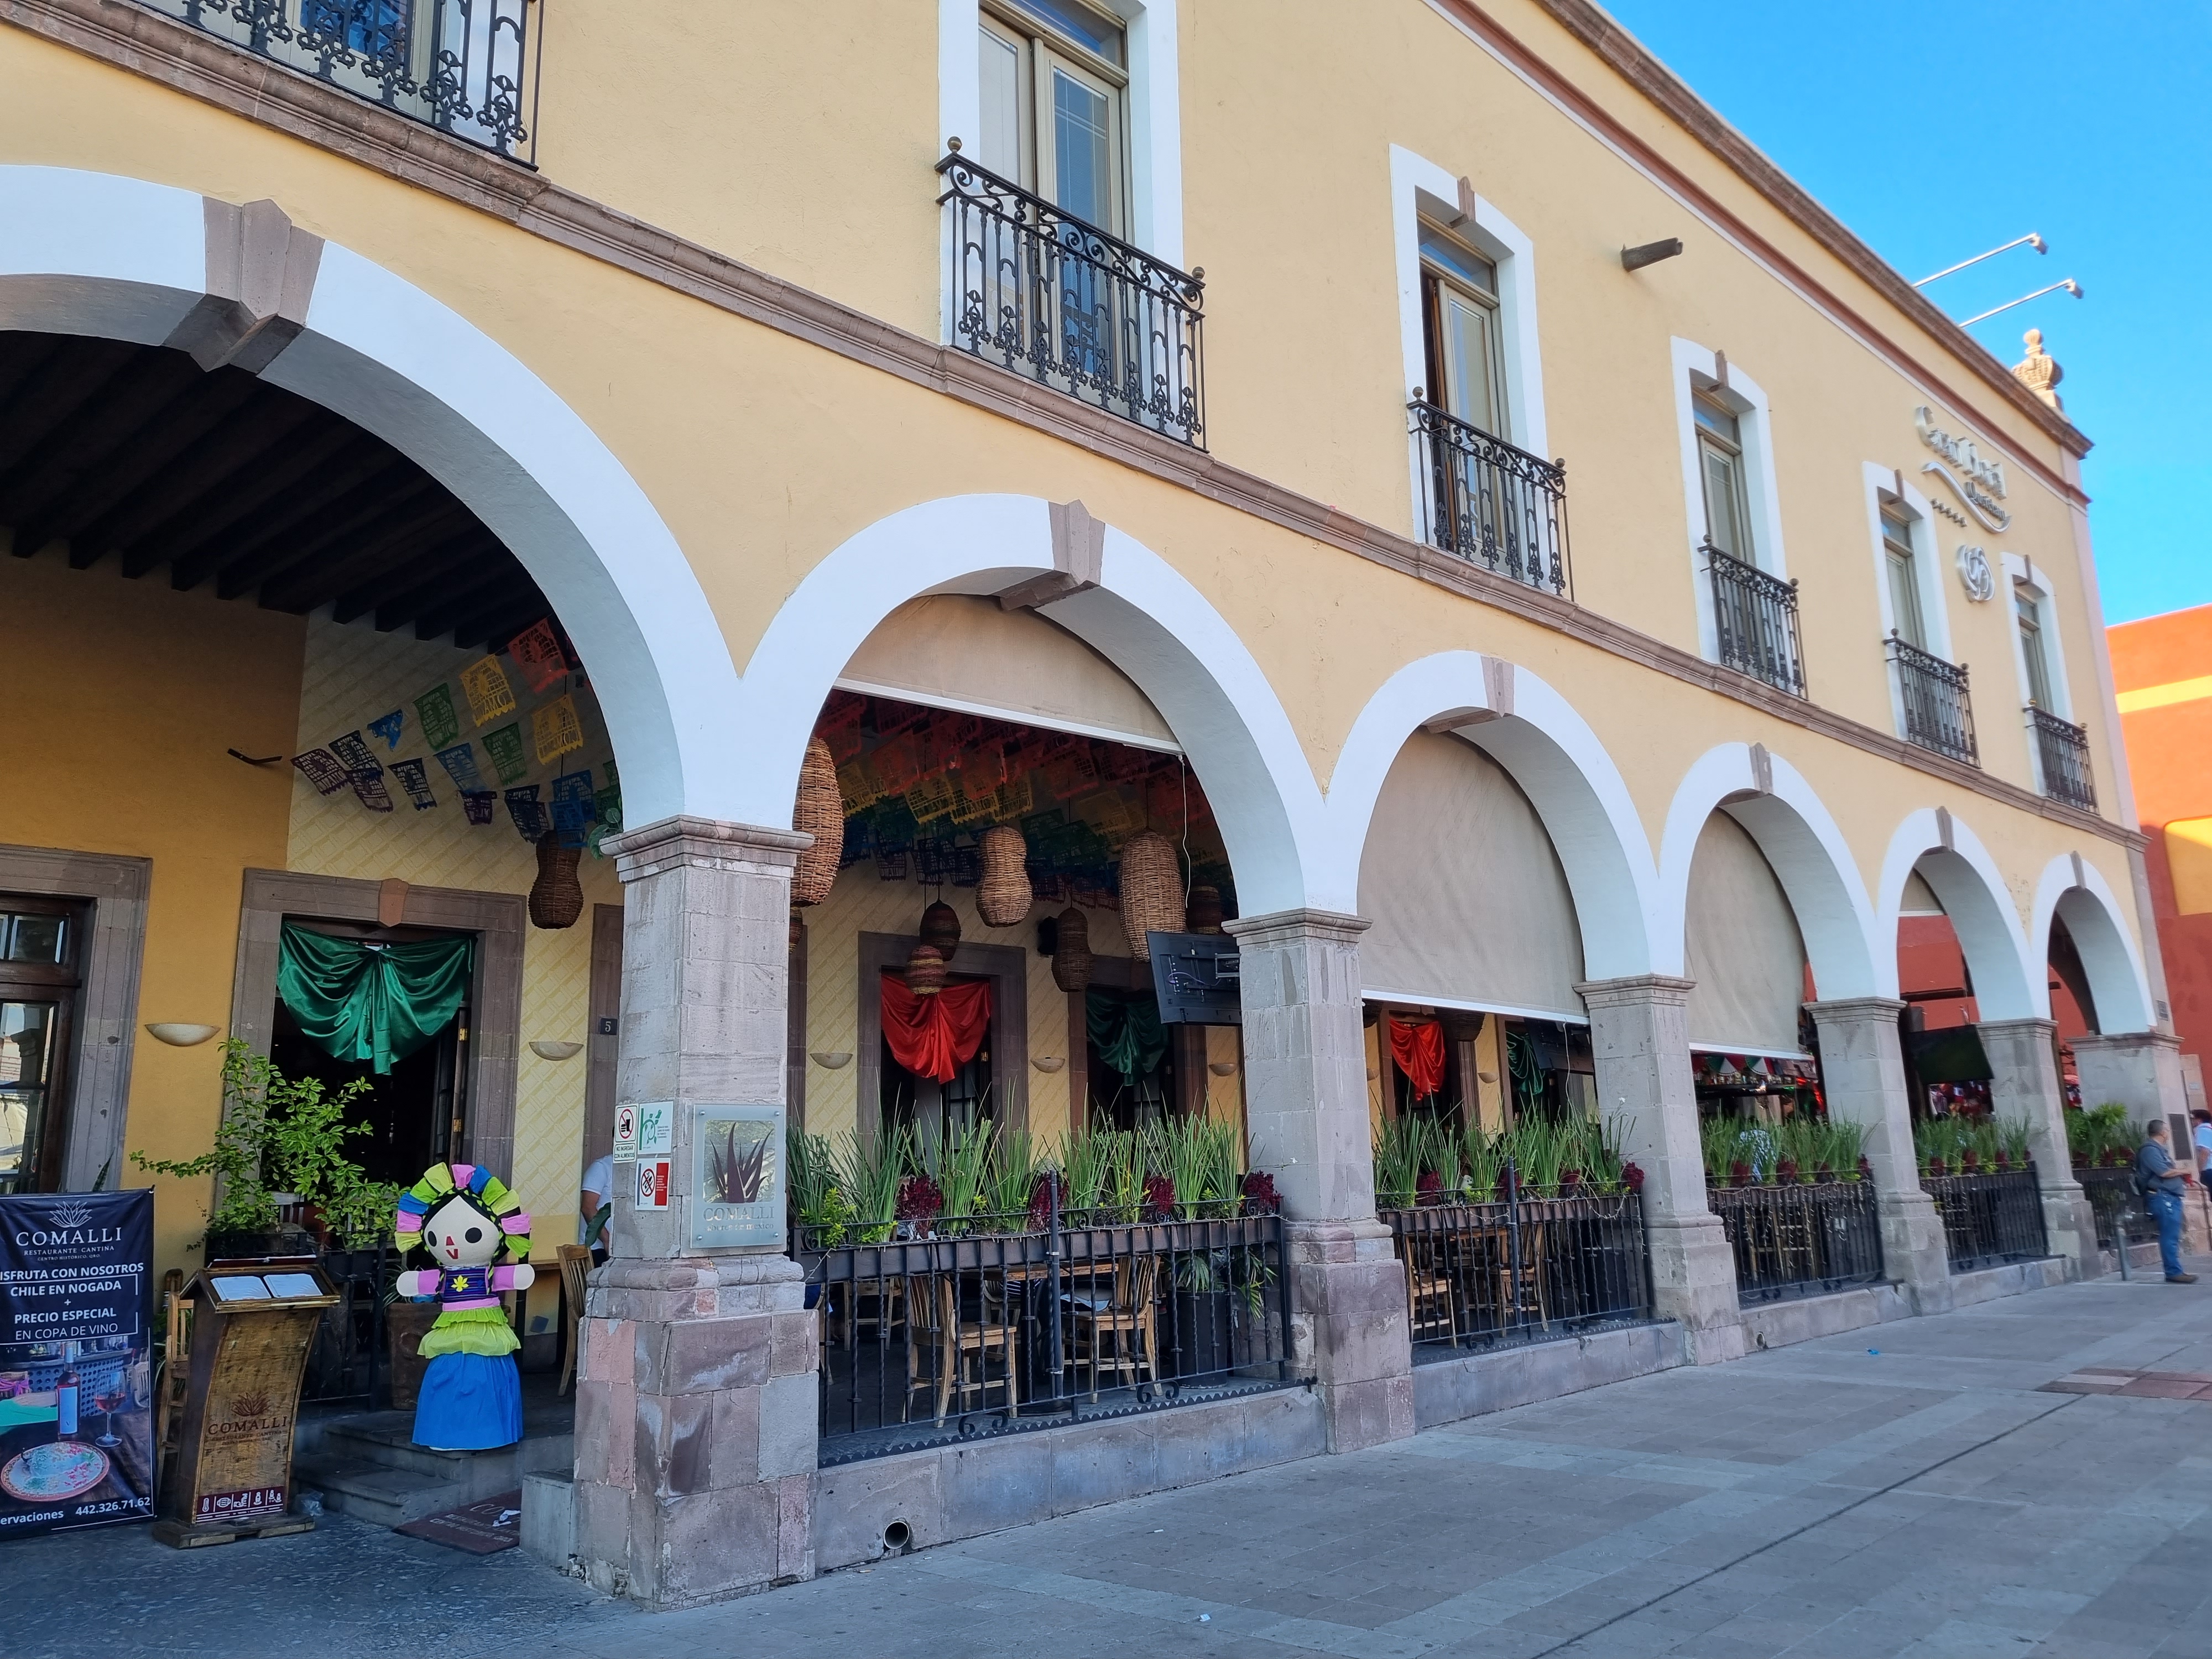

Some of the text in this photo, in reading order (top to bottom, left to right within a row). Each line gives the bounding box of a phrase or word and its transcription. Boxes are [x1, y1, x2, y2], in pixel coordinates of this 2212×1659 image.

[605, 1021, 612, 1032] 5
[703, 1206, 774, 1221] COMALLI
[16, 1227, 122, 1246] COMALLI
[24, 1248, 77, 1256] RESTAURANTE
[51, 1268, 77, 1279] CON
[81, 1262, 144, 1277] NOSOTROS
[11, 1281, 122, 1297] CHILE EN NOGADA
[14, 1308, 117, 1324] PRECIO ESPECIAL
[15, 1323, 118, 1340] EN COPA DE VINO
[208, 1416, 288, 1435] COMALLI
[75, 1496, 150, 1516] 442.326.71.62
